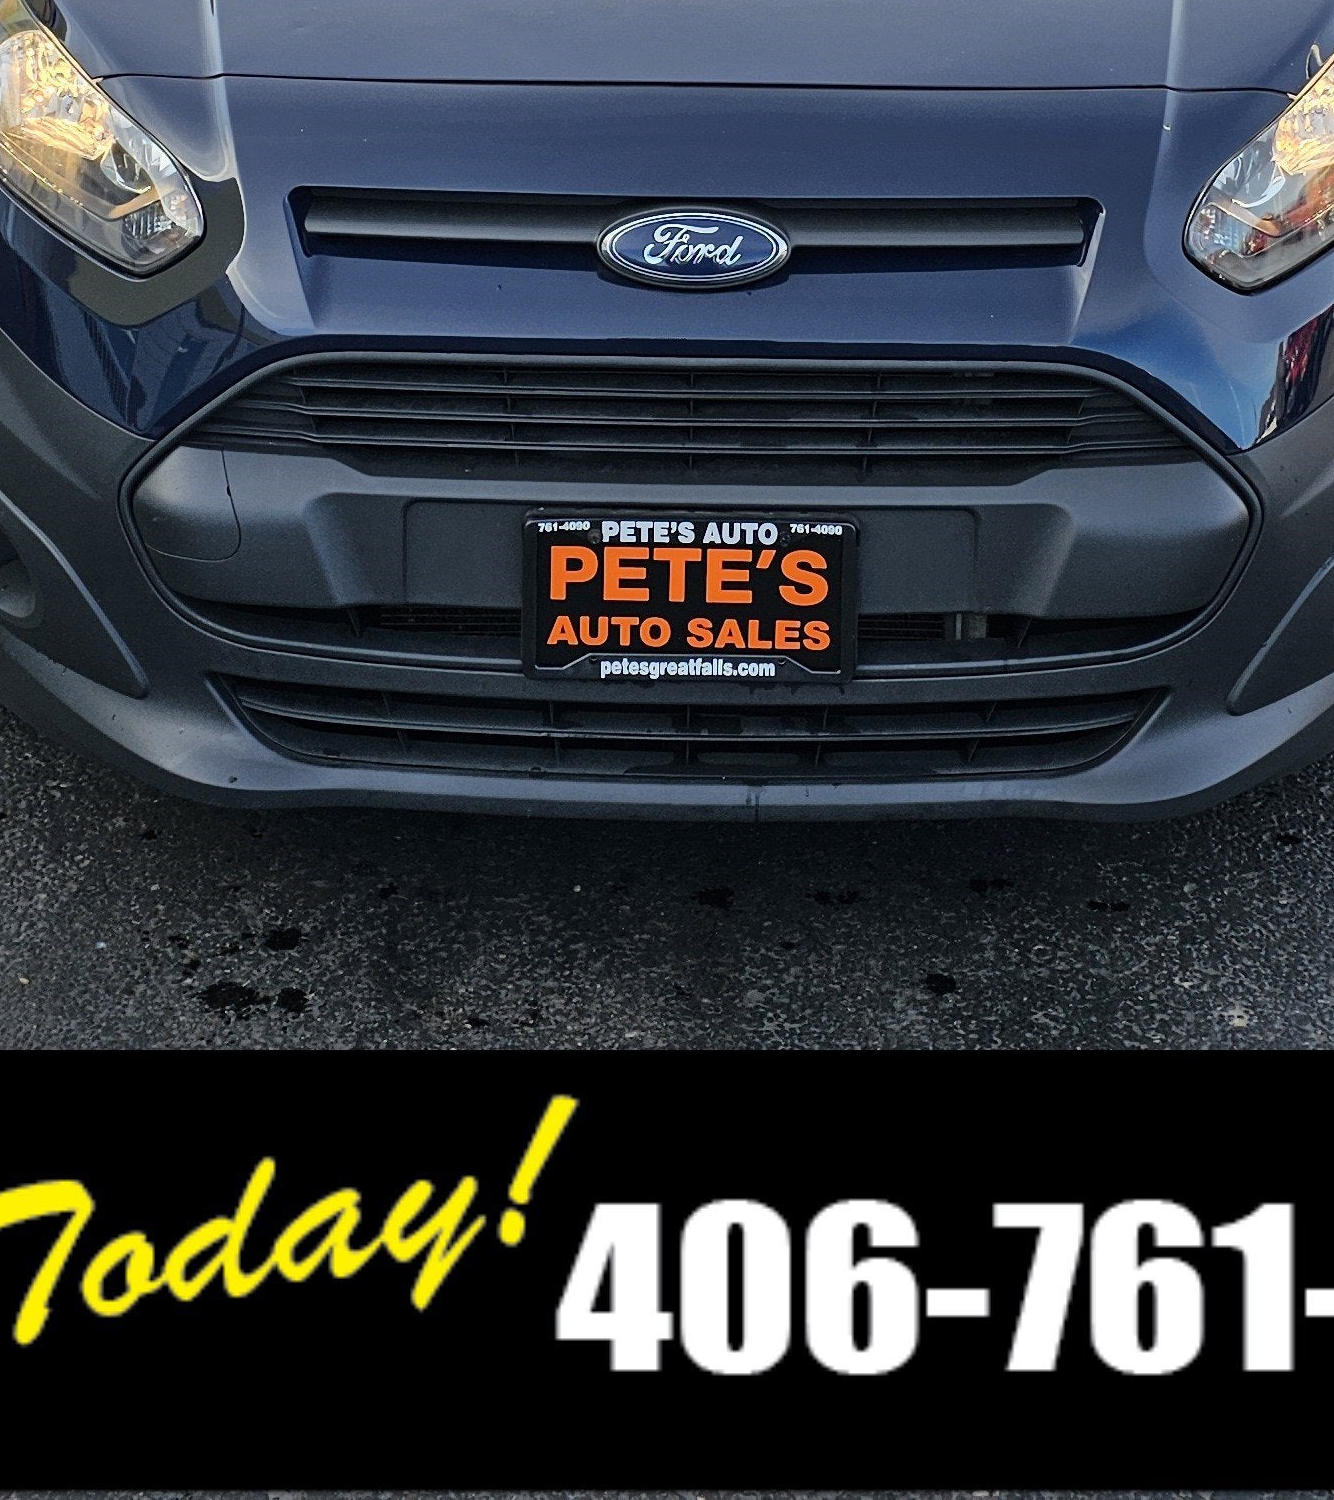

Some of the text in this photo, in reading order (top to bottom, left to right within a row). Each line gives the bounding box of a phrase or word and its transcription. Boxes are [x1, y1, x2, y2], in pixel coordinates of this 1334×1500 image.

[643, 223, 744, 266] Ford
[537, 521, 591, 533] 761-4090
[601, 520, 779, 545] PETE'S AUTO
[789, 523, 843, 536] 761-4090
[550, 545, 829, 606] PETE'S
[546, 615, 831, 651] AUTO SALES
[599, 658, 776, 680] petesgreatfalls.com
